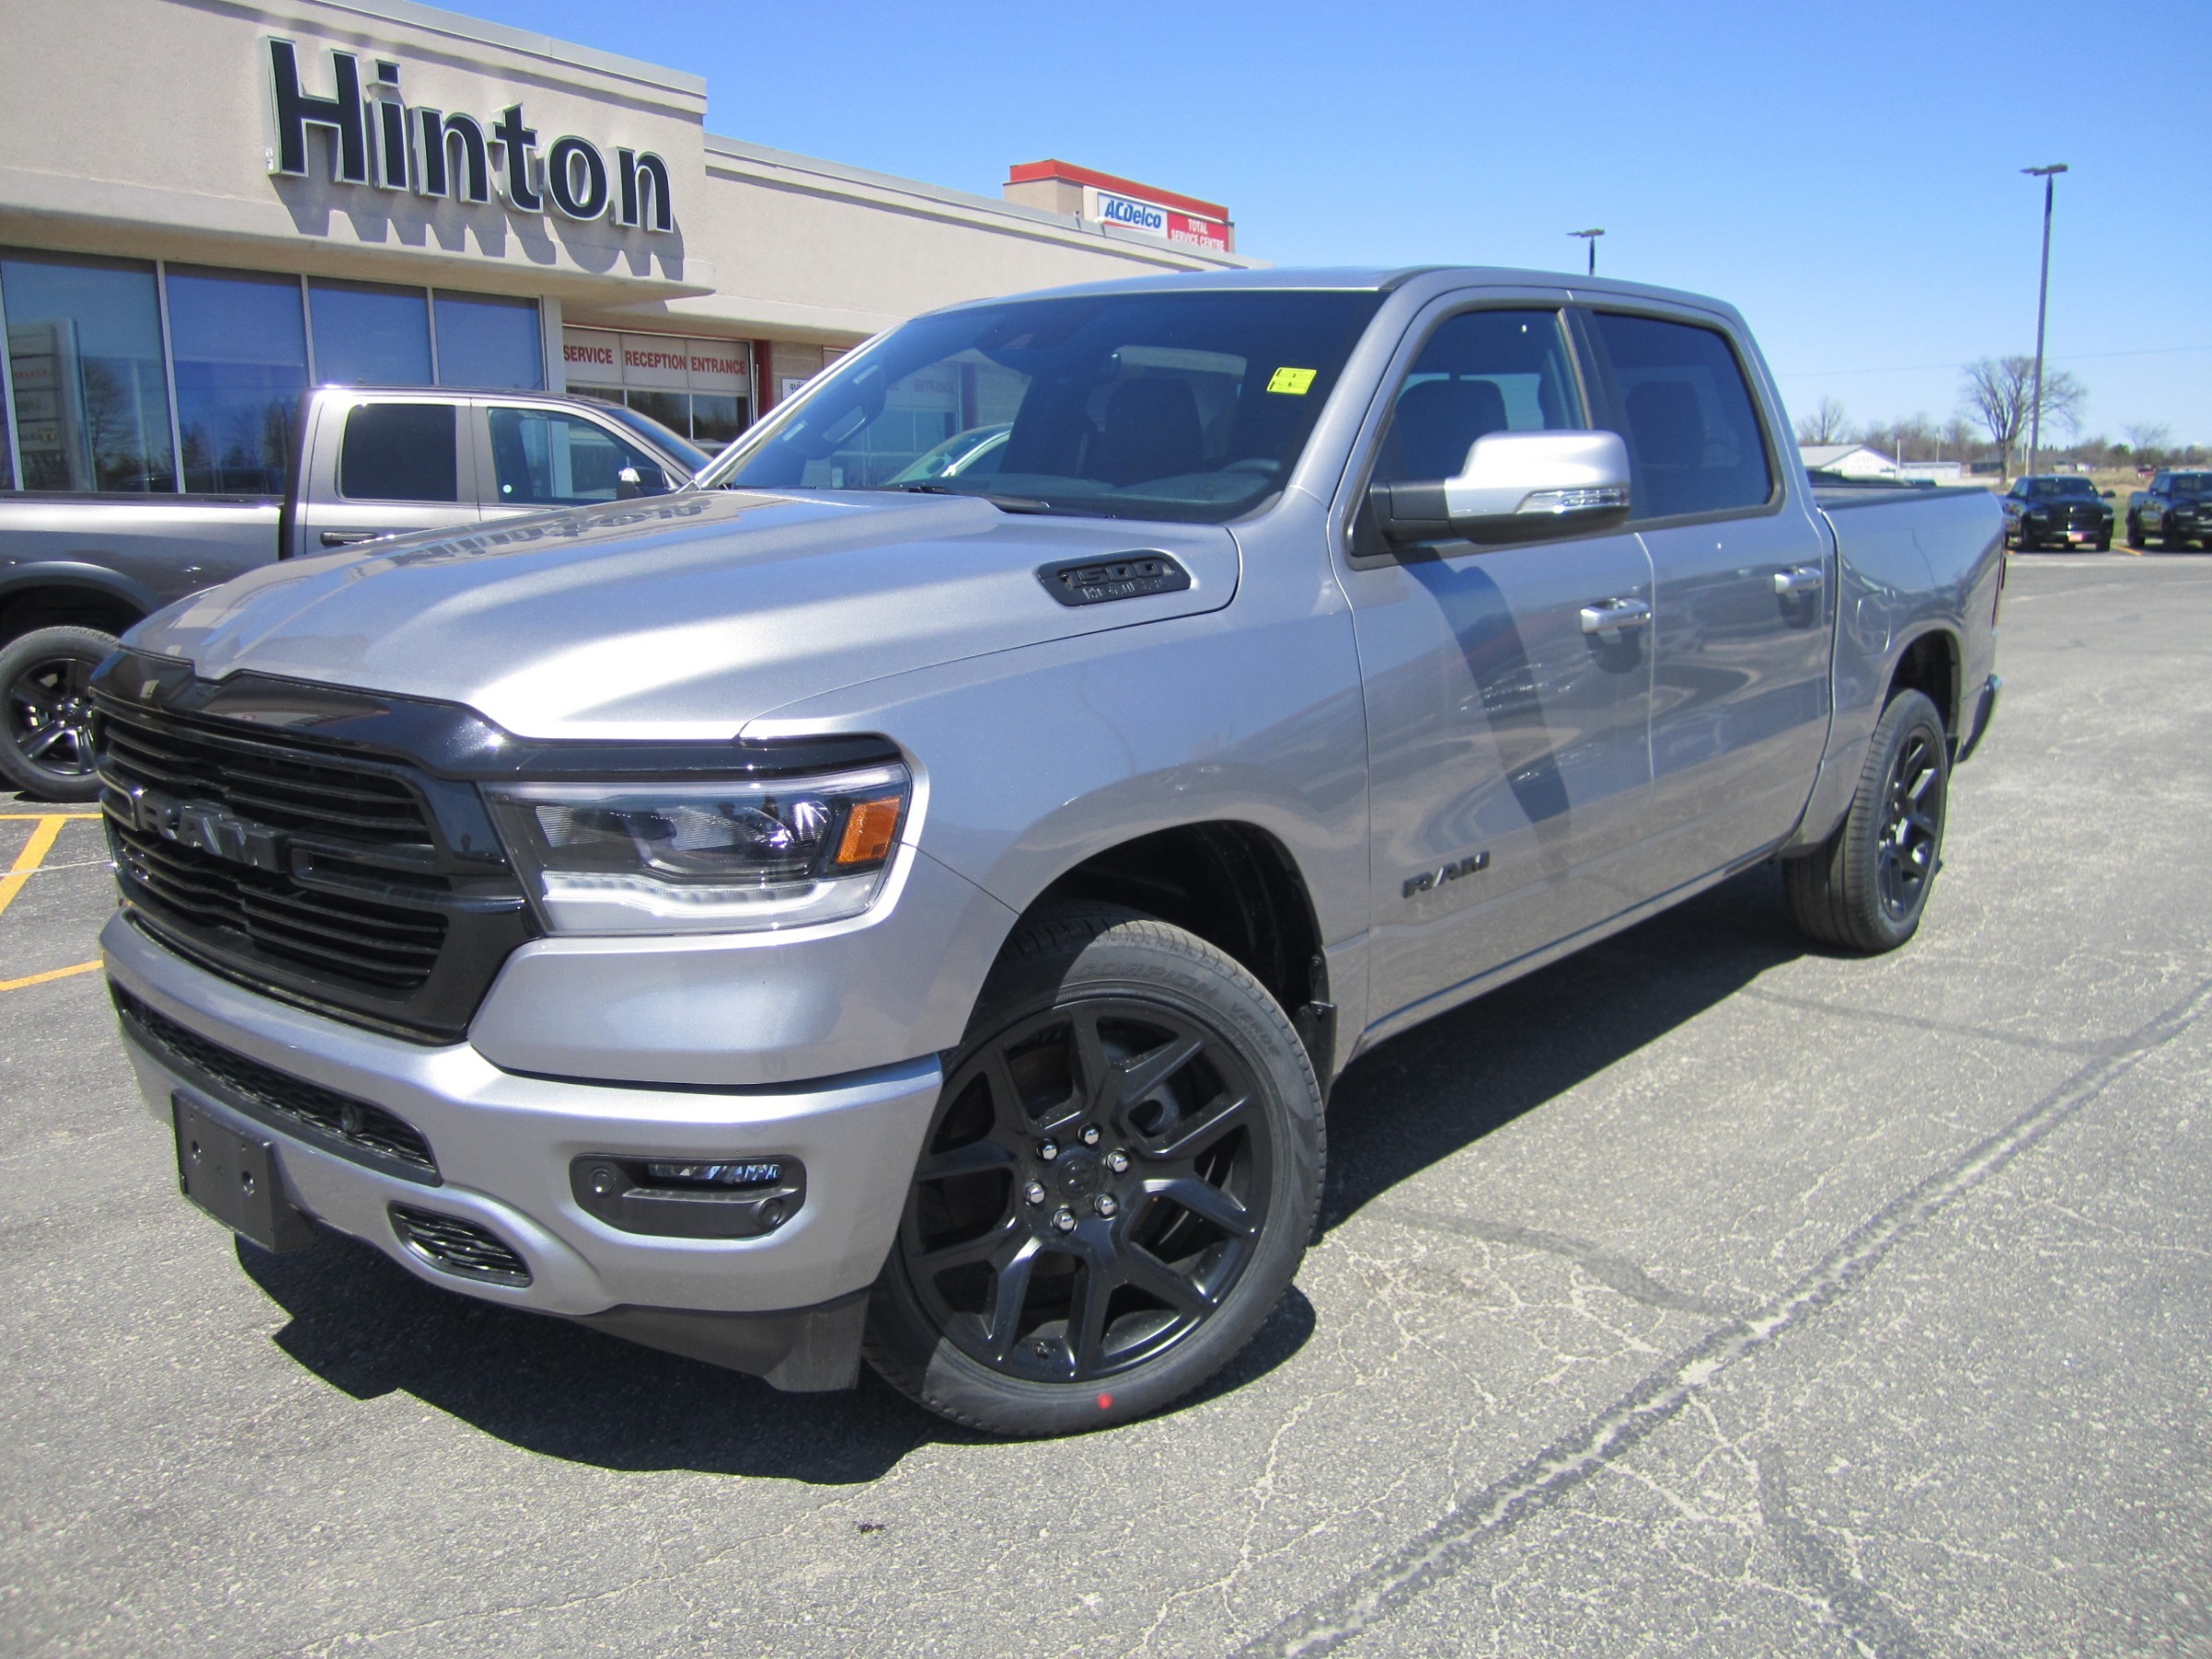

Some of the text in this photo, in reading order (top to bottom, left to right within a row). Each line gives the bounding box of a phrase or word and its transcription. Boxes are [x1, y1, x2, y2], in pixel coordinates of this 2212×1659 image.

[267, 36, 674, 233] Hinton
[1105, 200, 1161, 228] ACDelco
[1187, 218, 1207, 234] TOTAL
[1171, 229, 1225, 249] SERVICE CENTRE
[563, 345, 746, 374] SERVICE RECEPTION ENTRANCE
[1061, 559, 1163, 589] 1500
[135, 795, 288, 874] RAM
[1402, 850, 1490, 899] RAM
[1071, 961, 1219, 1000] CORPION
